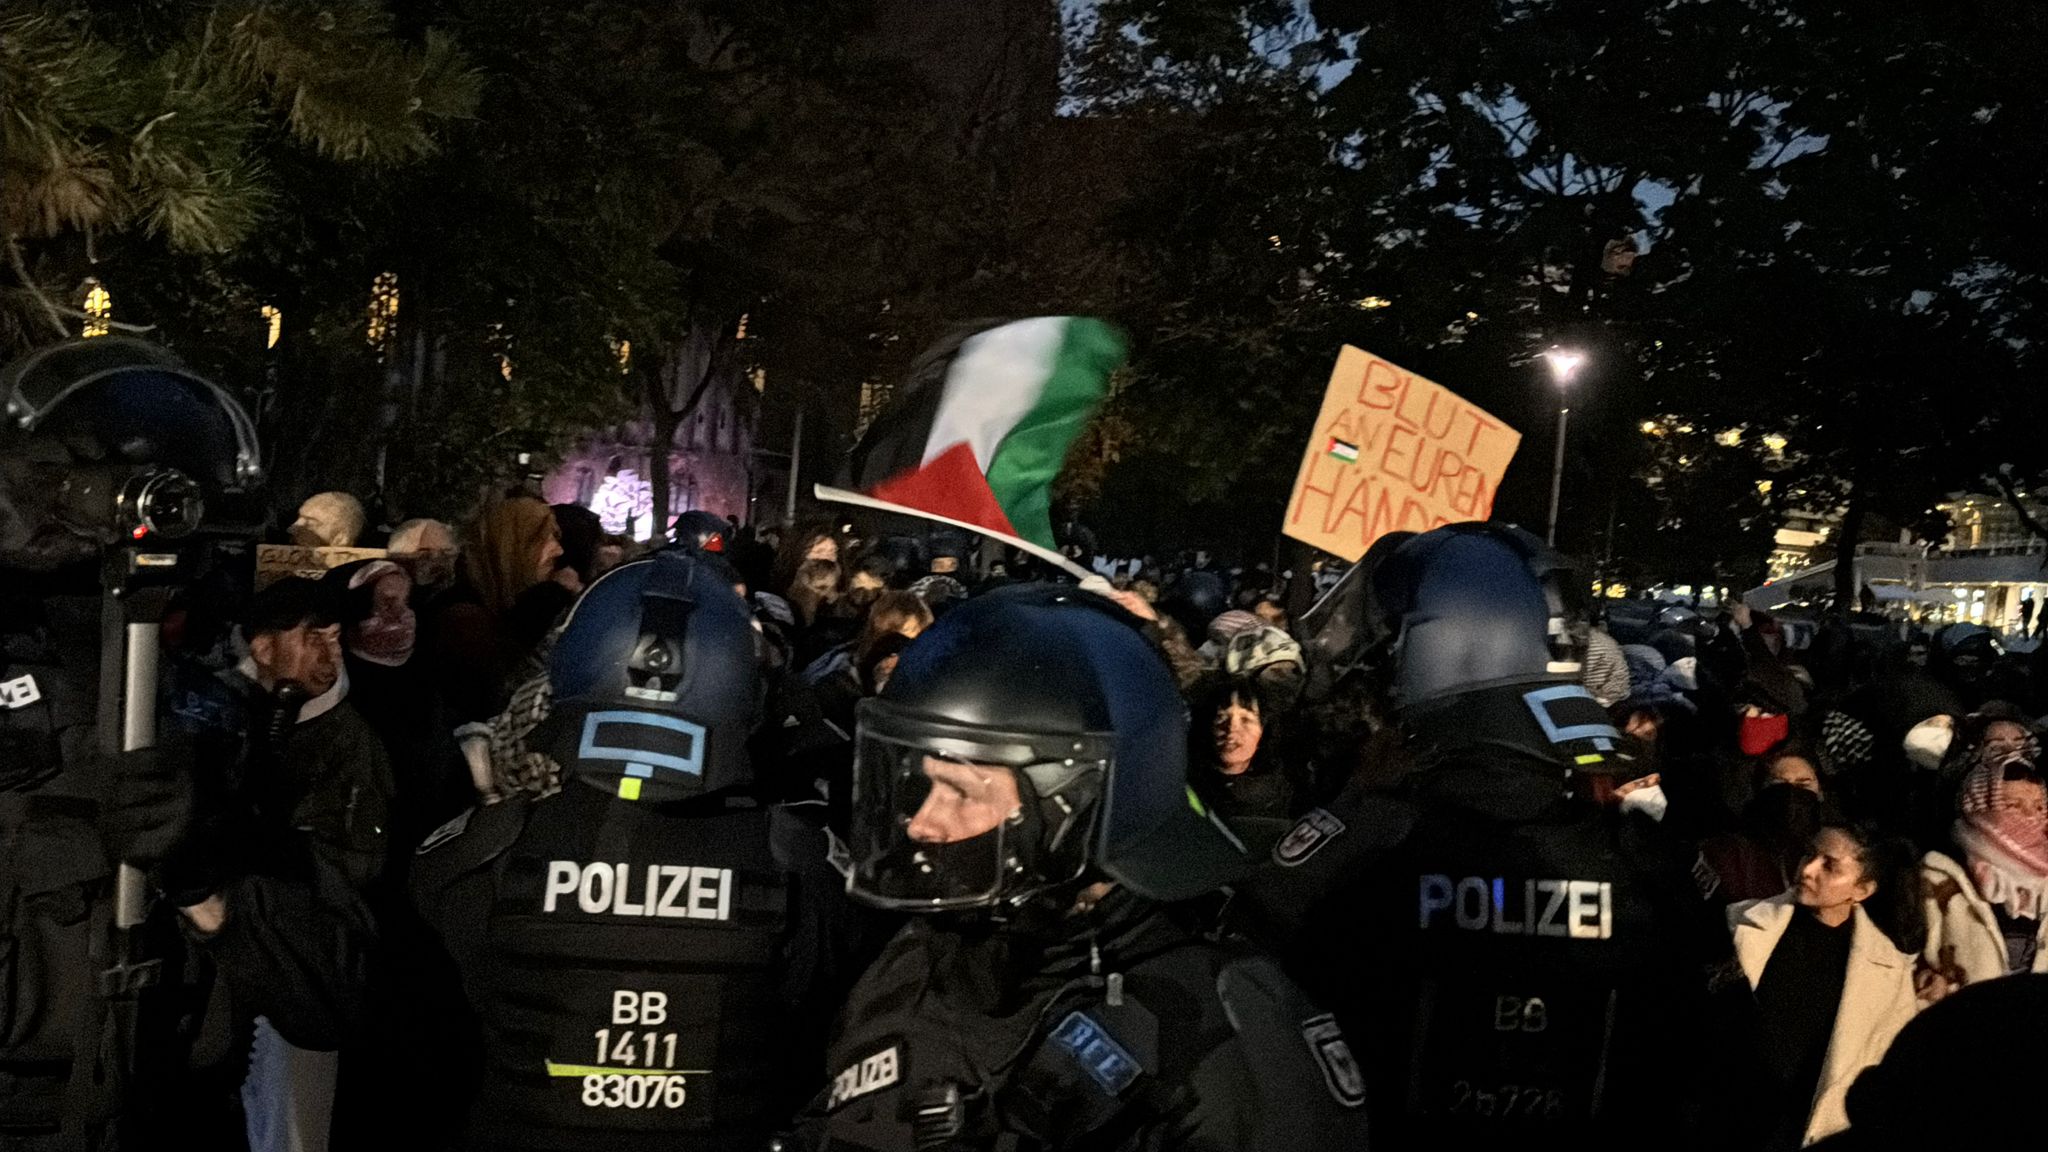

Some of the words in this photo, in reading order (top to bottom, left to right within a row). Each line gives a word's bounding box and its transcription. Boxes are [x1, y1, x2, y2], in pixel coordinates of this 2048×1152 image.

[1357, 360, 1500, 457] BLUT
[1324, 407, 1384, 451] AN
[1380, 423, 1493, 523] EUREN
[1291, 450, 1451, 547] HÄND
[543, 860, 733, 921] POLIZEI
[1417, 873, 1613, 940] POLIZEI
[611, 989, 669, 1026] BB
[594, 1028, 678, 1069] 1411
[581, 1073, 687, 1109] 83076
